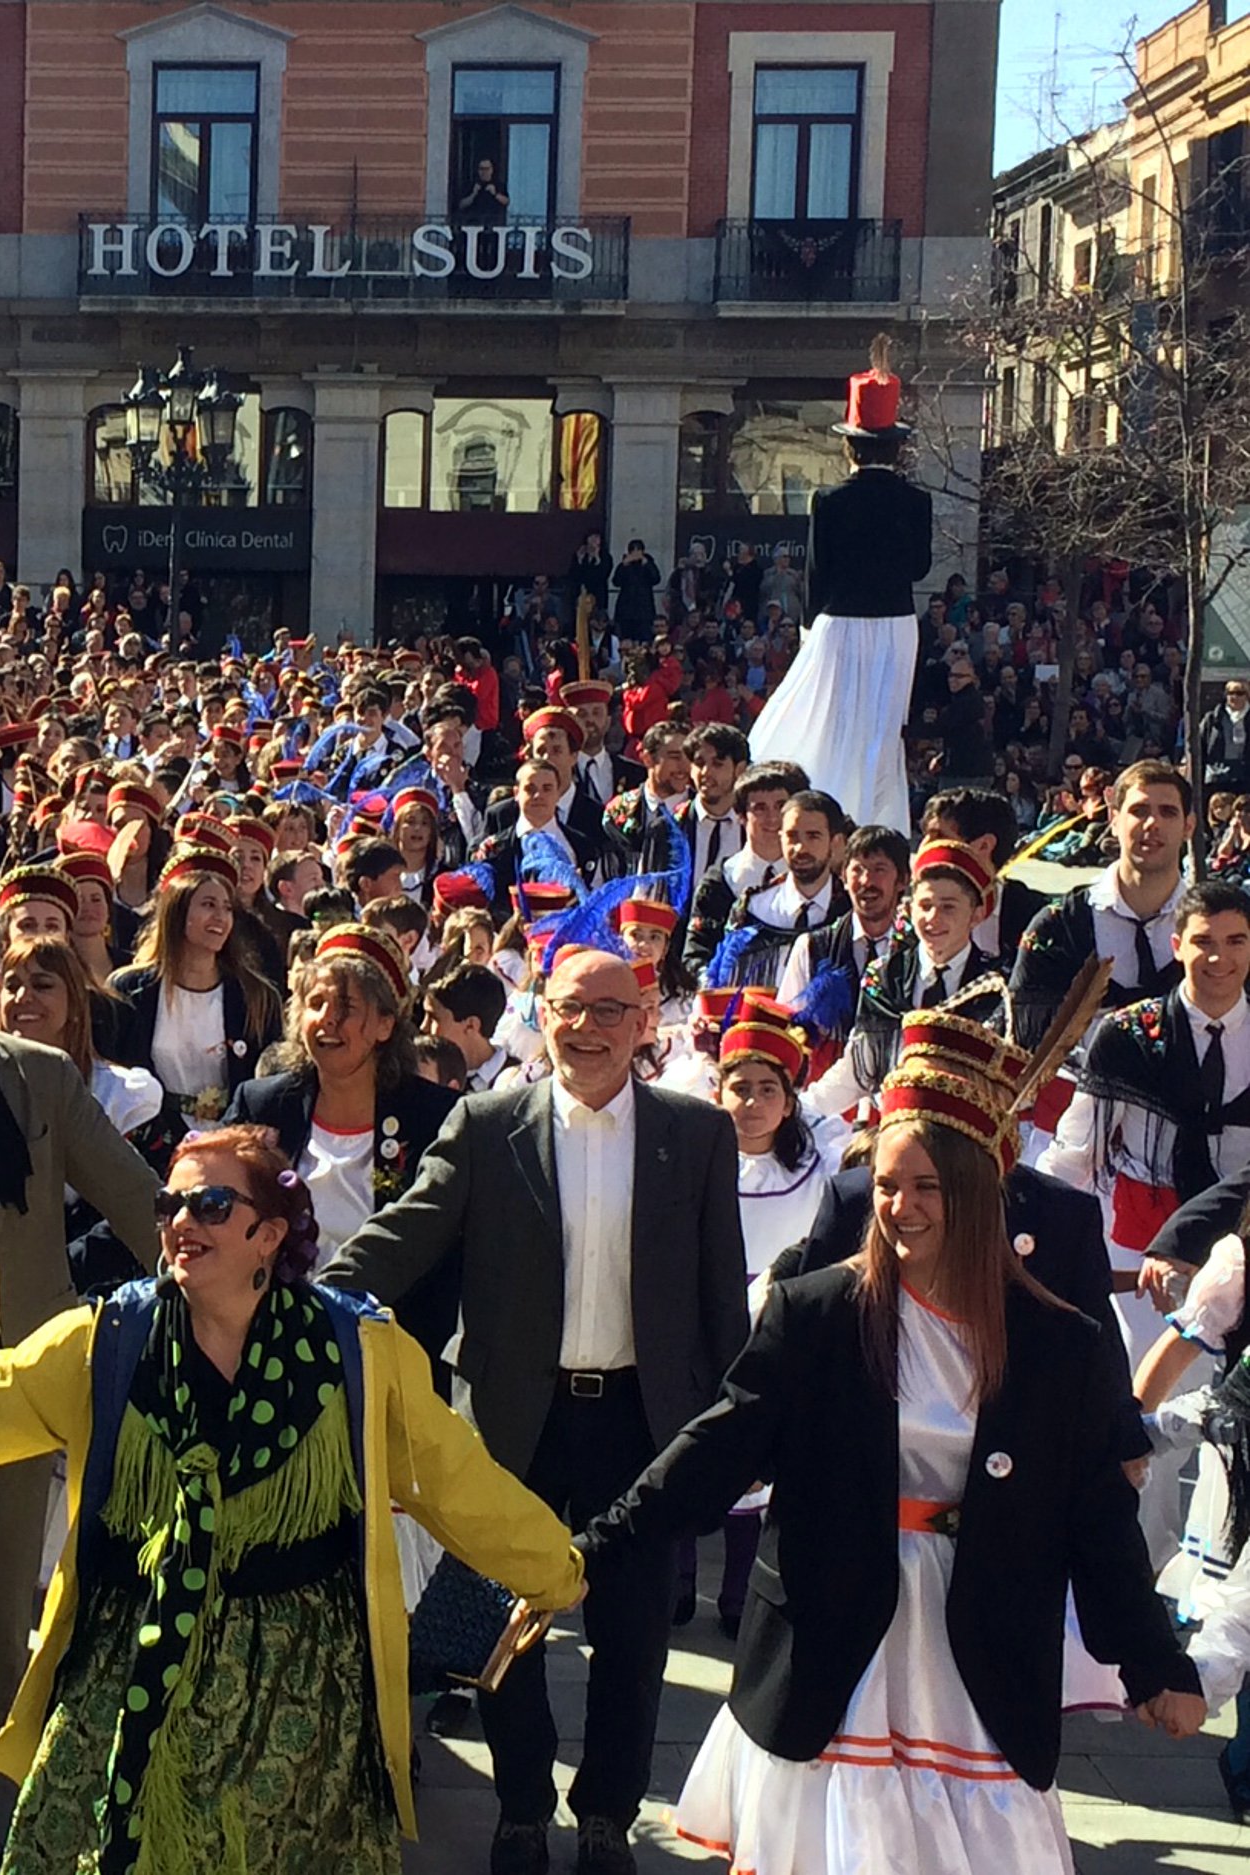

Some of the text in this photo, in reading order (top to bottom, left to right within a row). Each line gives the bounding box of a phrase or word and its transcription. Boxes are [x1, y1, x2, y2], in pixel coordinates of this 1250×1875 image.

[86, 223, 593, 280] HOTEL SUIS
[138, 530, 293, 548] iDen Clínica Dental
[726, 539, 772, 559] iDnt
